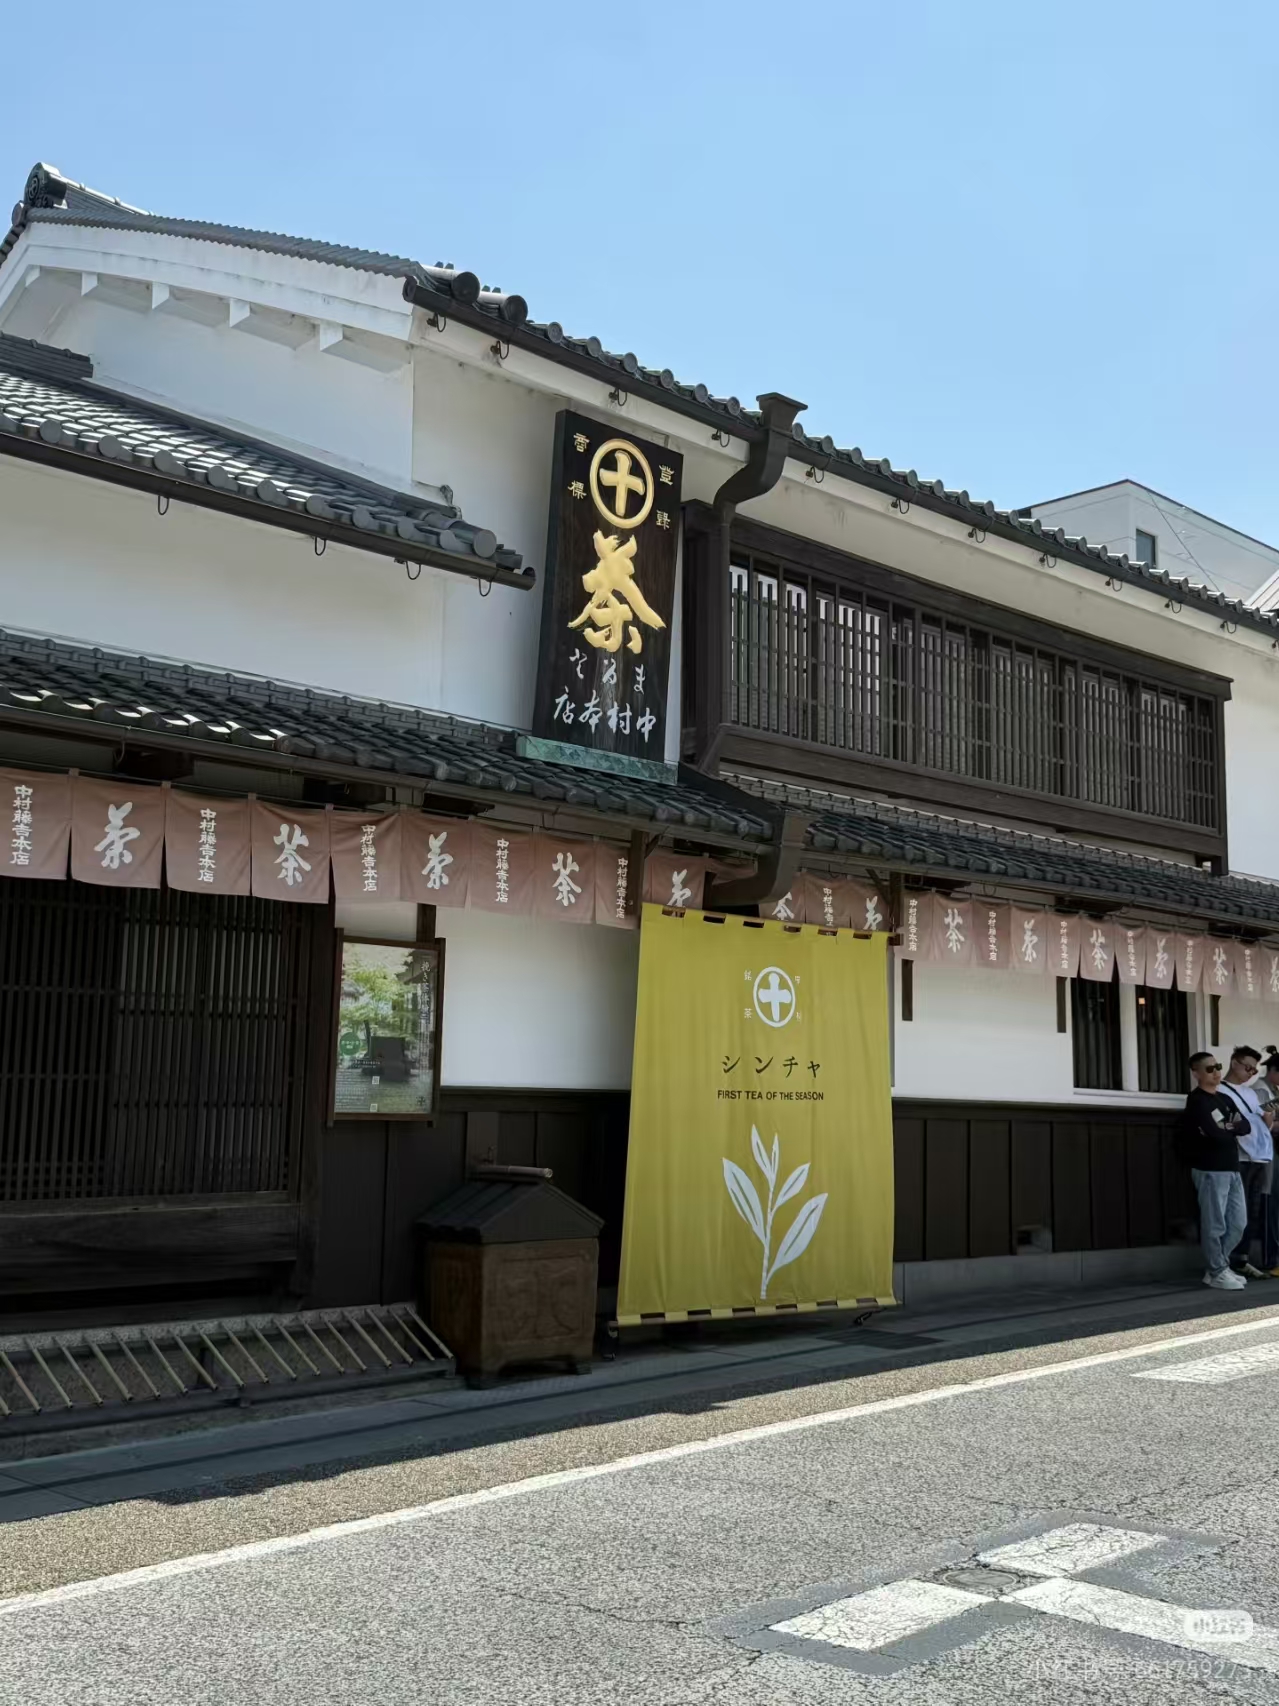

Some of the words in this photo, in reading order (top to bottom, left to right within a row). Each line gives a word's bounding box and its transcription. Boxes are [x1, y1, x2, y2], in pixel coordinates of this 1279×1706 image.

[567, 529, 667, 655] 茶
[94, 801, 141, 869] 茶
[273, 823, 312, 886] 茶
[422, 831, 453, 890] 茶
[552, 852, 582, 907] 茶
[944, 908, 965, 953] 茶
[1021, 919, 1039, 963] 茶
[1089, 928, 1108, 971] 茶
[1212, 946, 1229, 986] 茶
[720, 1055, 822, 1079] シンチャ
[717, 1089, 743, 1100] FIRST
[744, 1090, 763, 1100] TEA
[766, 1091, 777, 1100] OF
[780, 1091, 794, 1100] THE
[795, 1091, 824, 1101] SEASON
